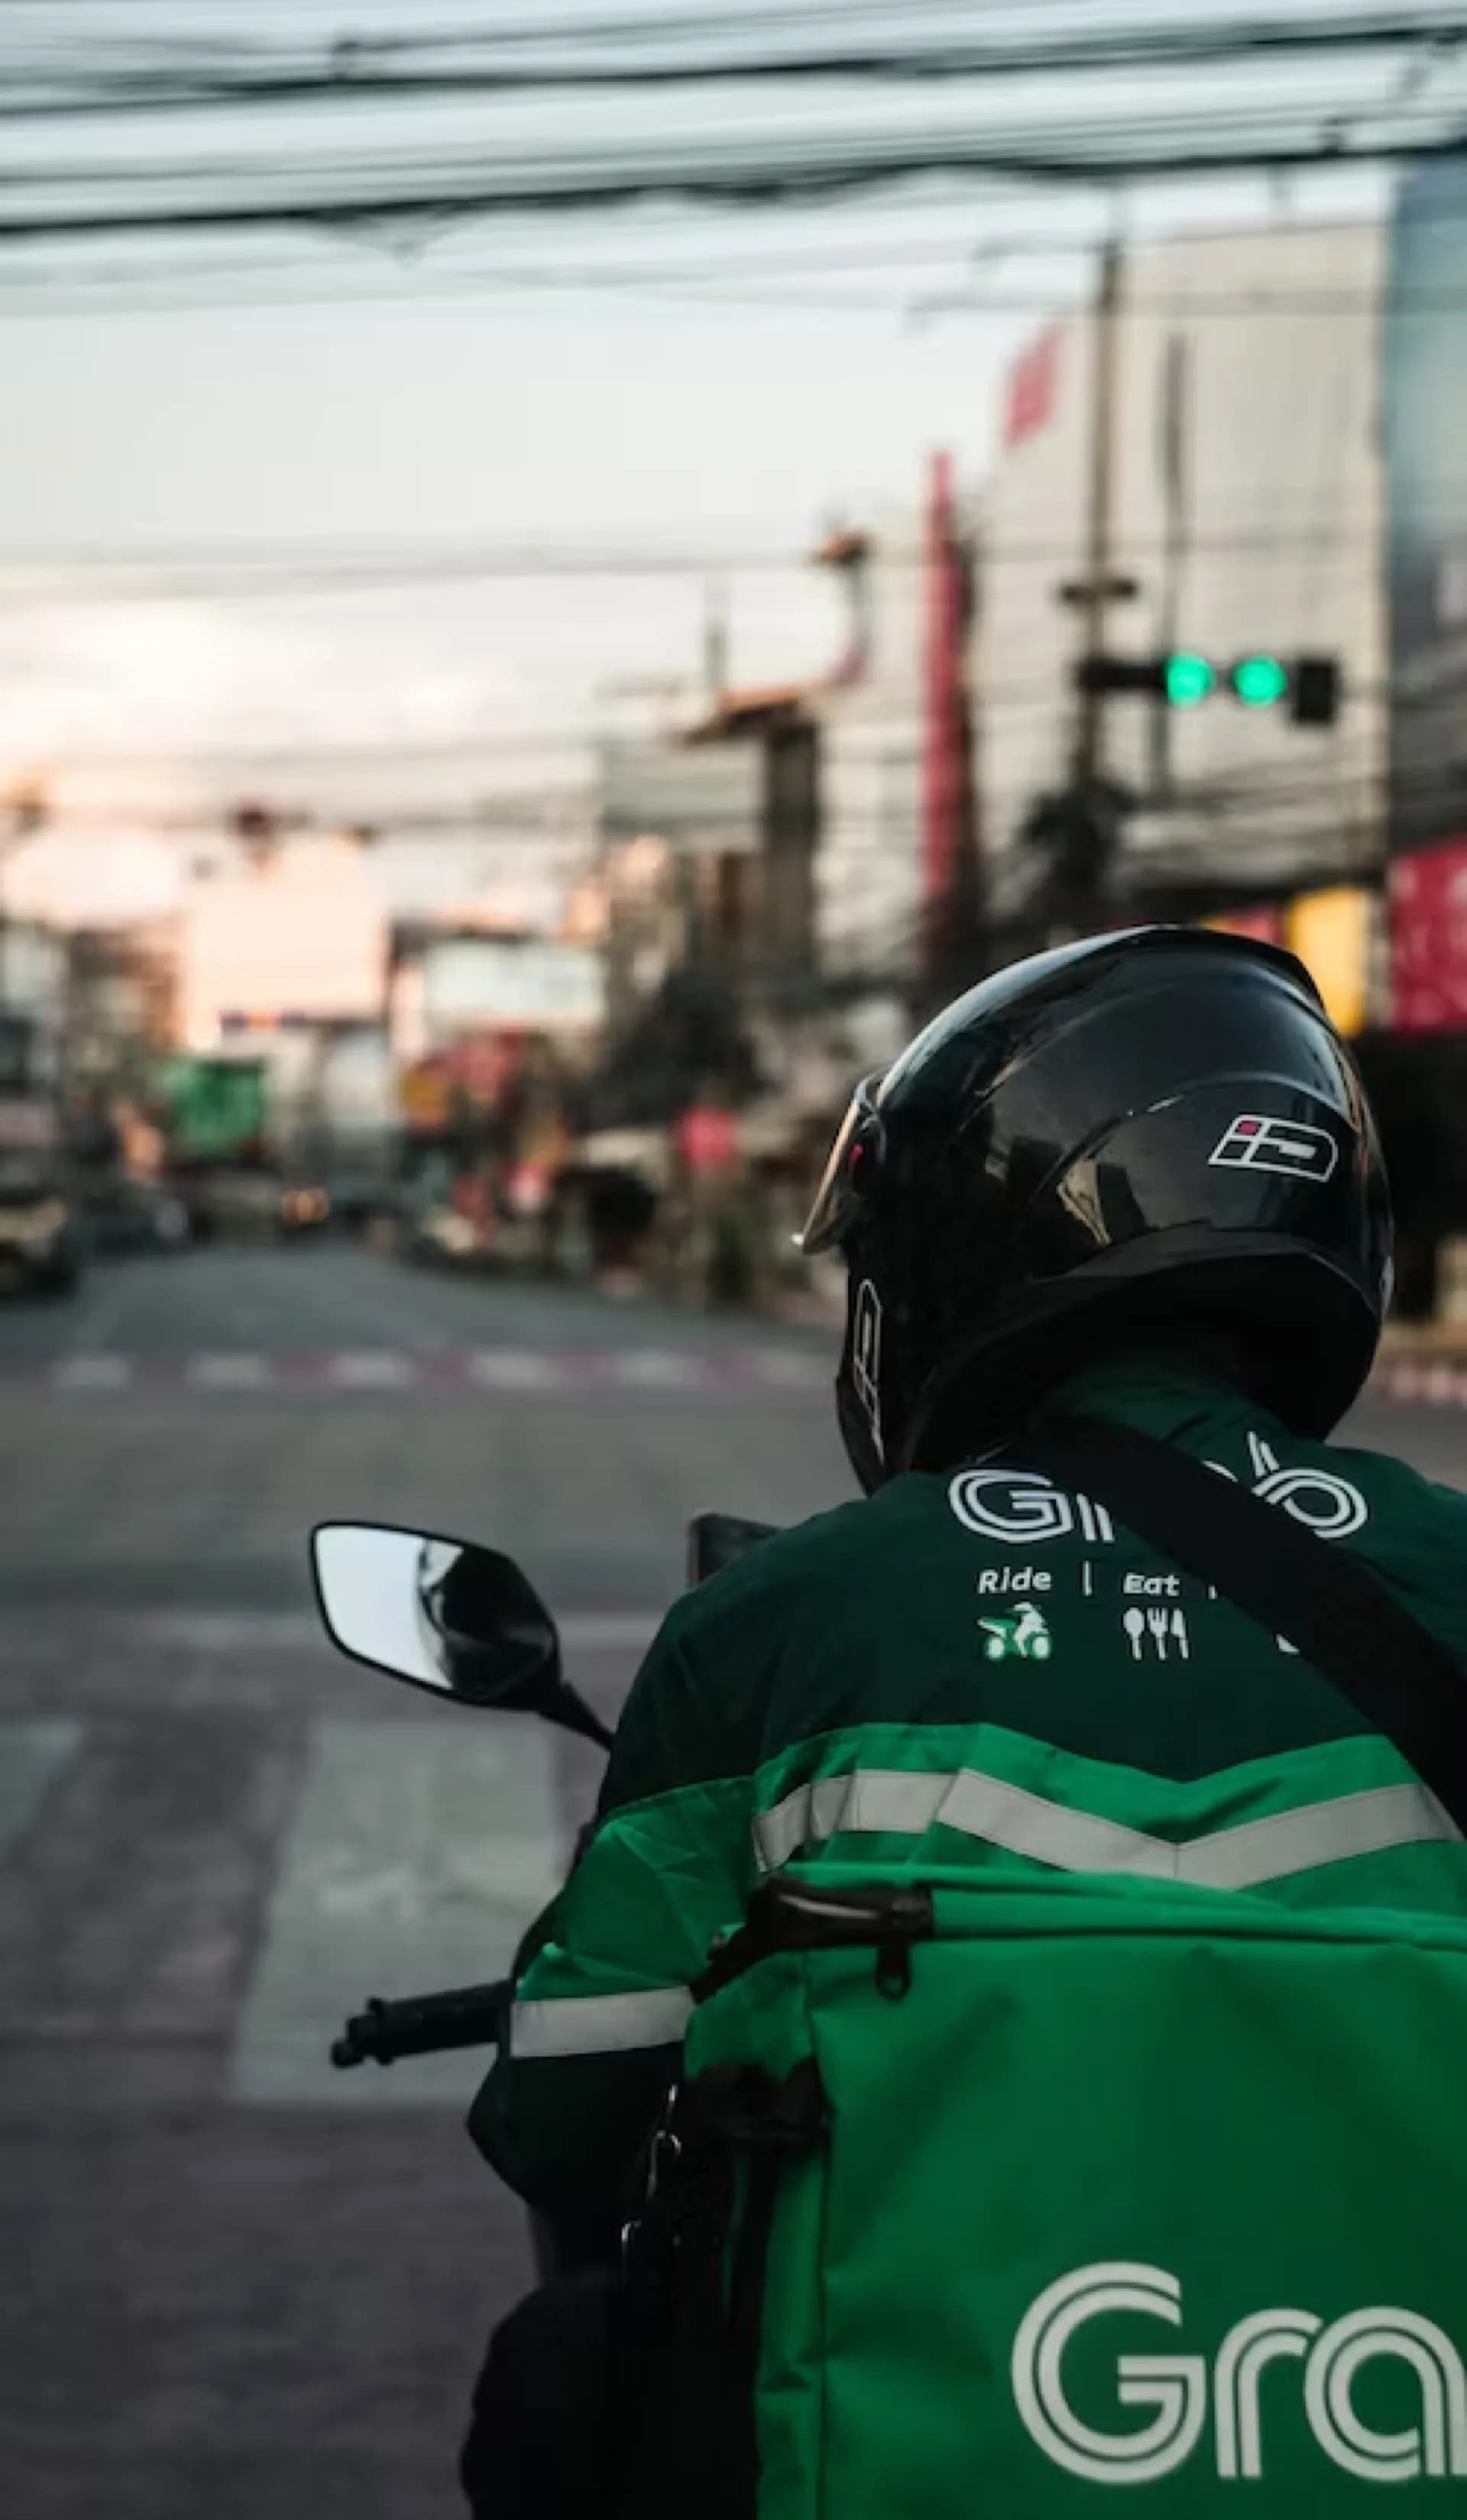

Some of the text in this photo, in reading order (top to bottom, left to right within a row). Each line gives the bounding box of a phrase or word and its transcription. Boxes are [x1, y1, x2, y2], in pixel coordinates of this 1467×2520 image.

[947, 1430, 1368, 1543] Gb
[977, 1566, 1180, 1596] Ride Eat
